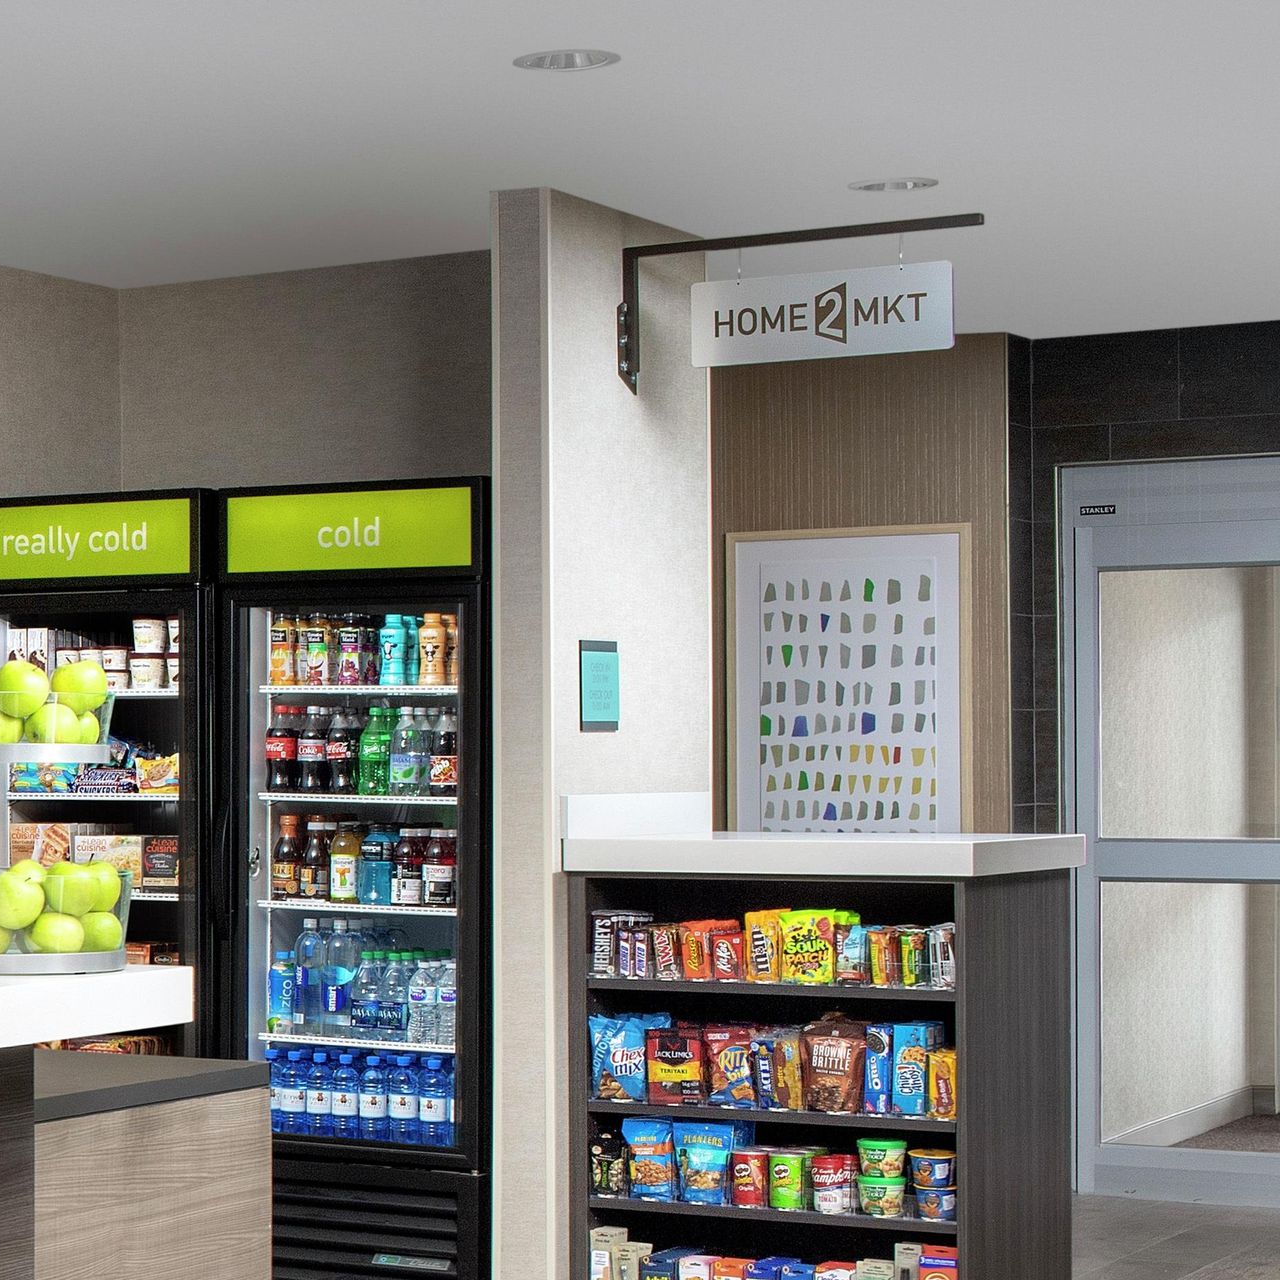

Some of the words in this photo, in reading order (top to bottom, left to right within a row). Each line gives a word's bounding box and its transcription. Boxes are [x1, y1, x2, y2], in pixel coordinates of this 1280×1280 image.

[1081, 506, 1114, 514] STANLEY
[317, 516, 380, 548] cold
[2, 525, 80, 561] really
[88, 521, 148, 553] cold
[145, 845, 178, 853] cuisine
[593, 918, 612, 971] HERSHEY'S
[654, 928, 674, 971] TWIX
[786, 939, 828, 953] SOUR
[786, 950, 828, 967] PATCH
[280, 979, 293, 1008] zico
[328, 986, 337, 1012] smart
[611, 1047, 645, 1064] Chex
[812, 1044, 852, 1060] BROWNIE
[614, 1060, 643, 1076] mix
[811, 1055, 851, 1071] BRITTLE
[870, 1055, 881, 1090] OREO
[898, 1070, 913, 1094] Chips
[683, 1135, 723, 1148] PLANTERS
